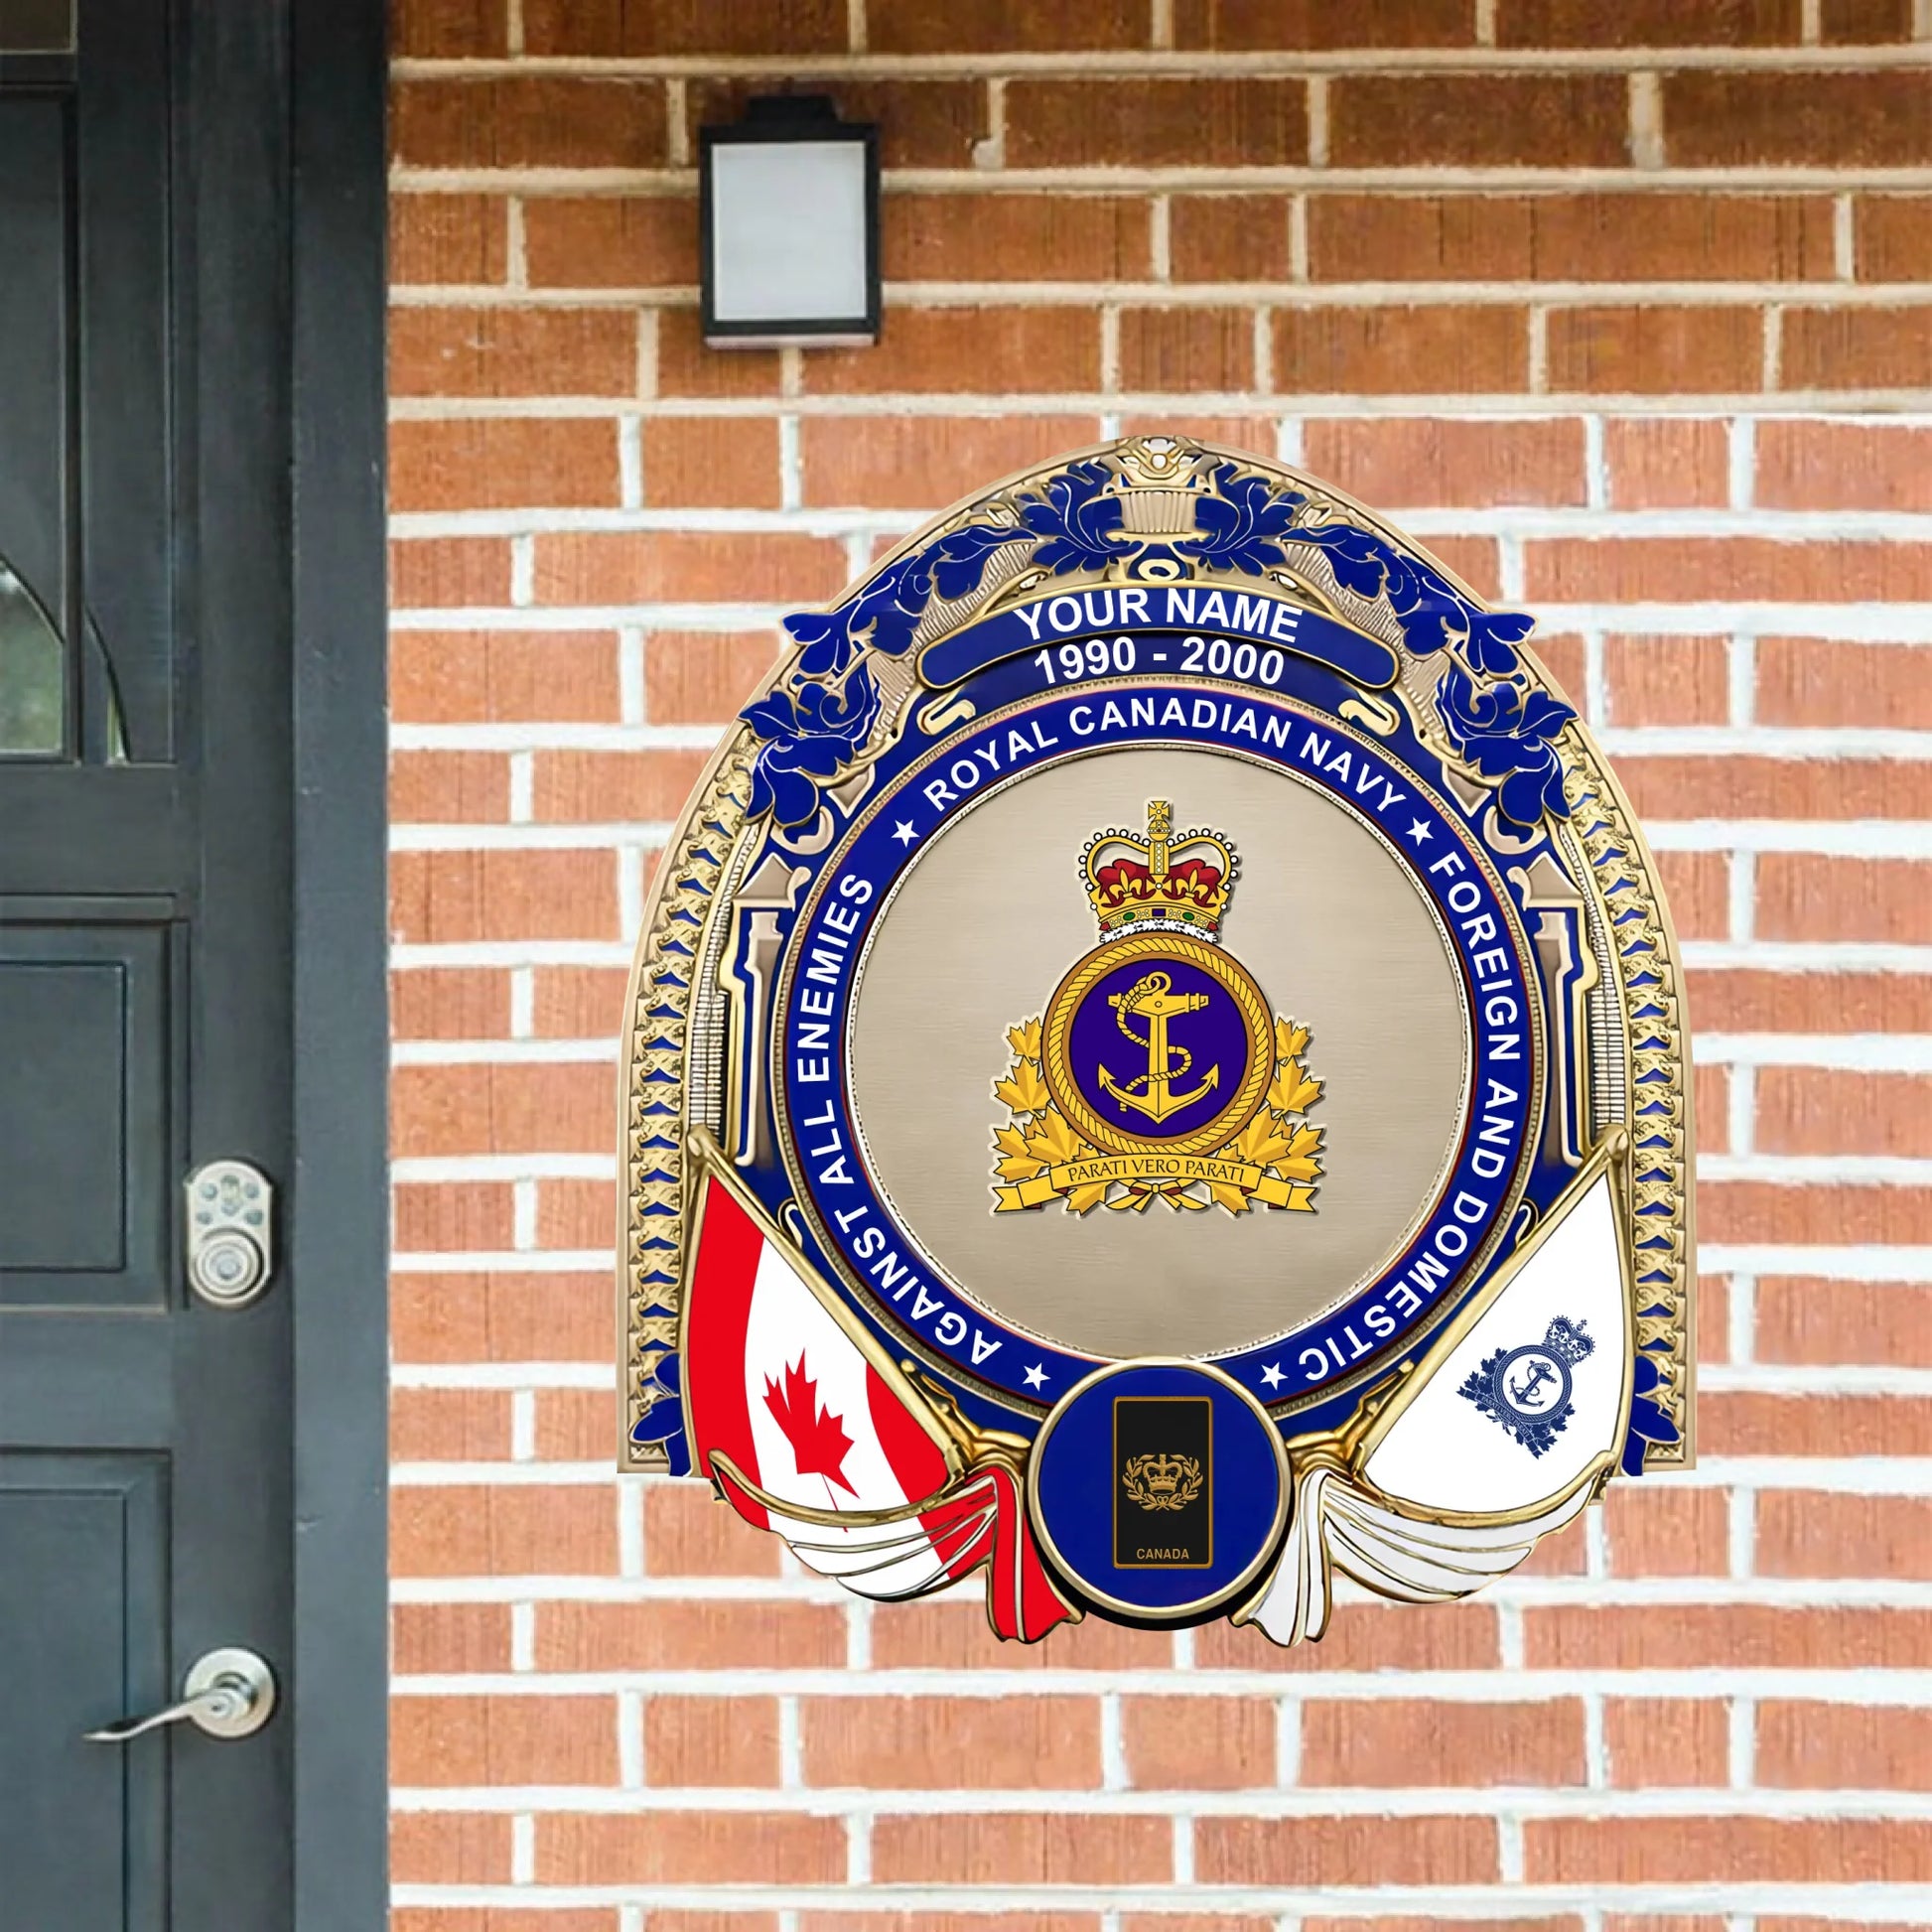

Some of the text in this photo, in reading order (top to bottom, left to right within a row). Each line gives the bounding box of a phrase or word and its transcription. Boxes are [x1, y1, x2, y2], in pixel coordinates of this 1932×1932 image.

[1013, 588, 1304, 643] YOUR NAME
[1034, 635, 1136, 684] 1990
[1180, 635, 1285, 685] 2000
[922, 697, 1407, 813] ROYAL CANADIAN NAVY
[797, 874, 1004, 1365] AGAINST ALL ENEMIES
[1298, 851, 1521, 1381] FOREIGN AND DOMESTIC
[1067, 1159, 1244, 1182] PARATI VERO PARATI
[1136, 1548, 1189, 1560] CANADA
